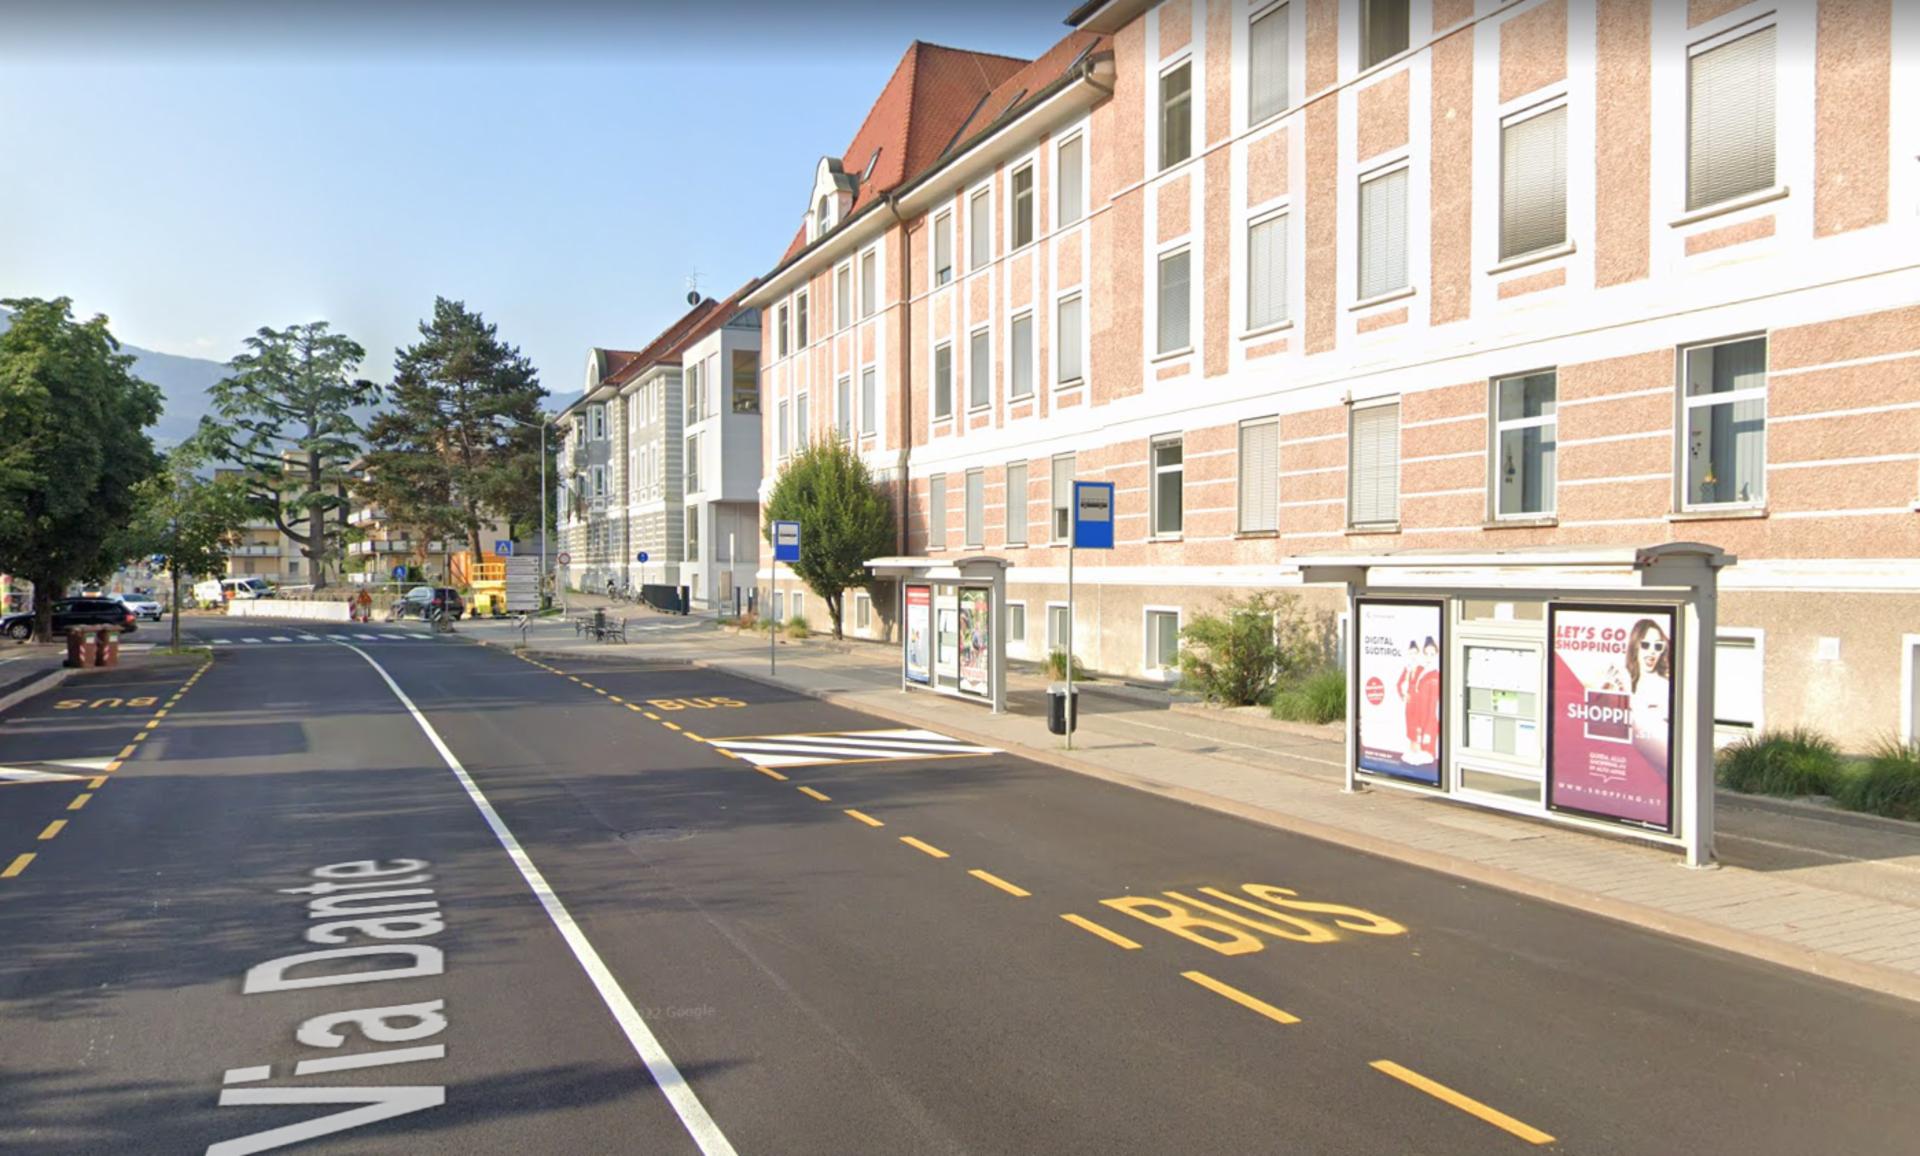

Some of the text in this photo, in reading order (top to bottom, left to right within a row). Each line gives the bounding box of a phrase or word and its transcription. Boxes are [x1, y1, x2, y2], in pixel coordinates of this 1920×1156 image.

[1556, 625, 1627, 641] LET'S GO
[1365, 635, 1394, 646] DIGITAL
[1555, 640, 1626, 654] SHOPPING!
[53, 697, 159, 709] BUS
[646, 697, 748, 711] BUS
[1567, 702, 1631, 725] SHOPPI
[1099, 883, 1408, 956] BUS
